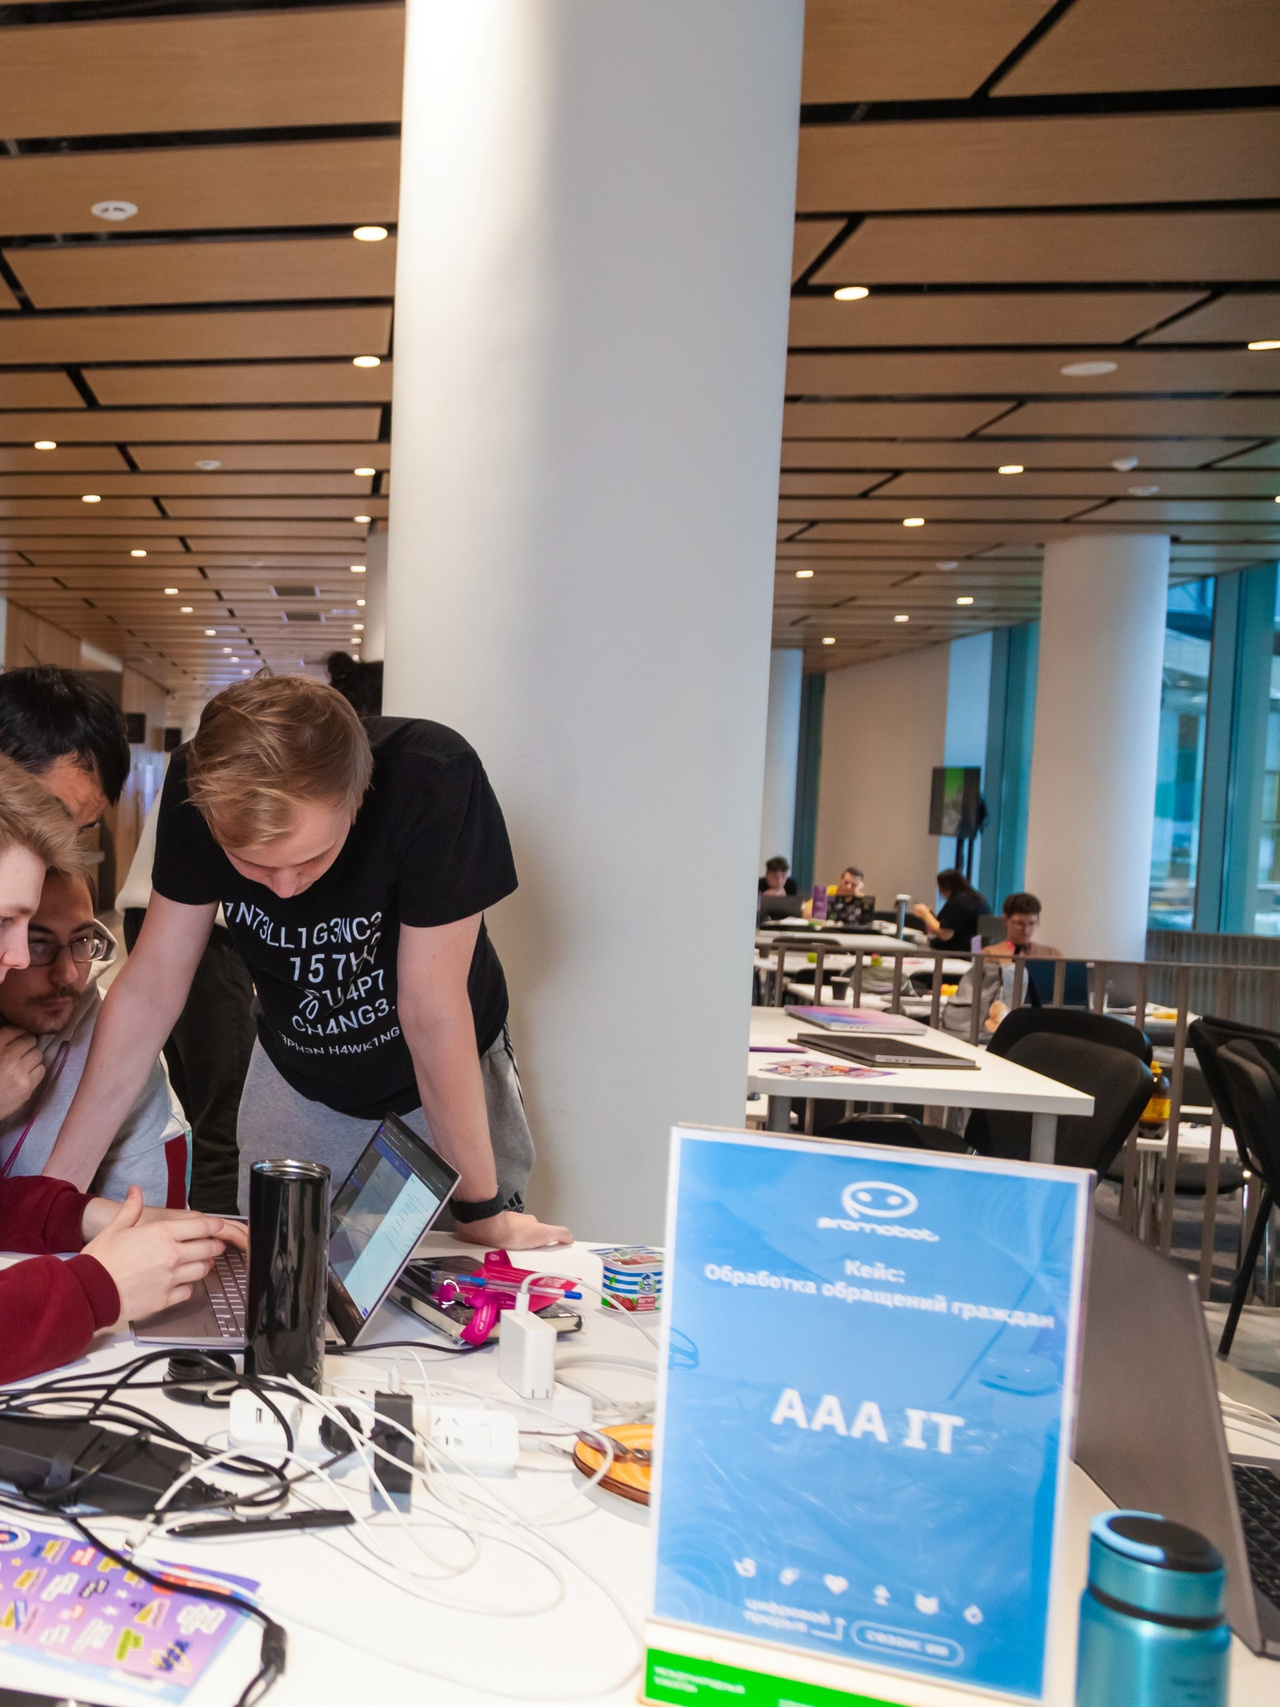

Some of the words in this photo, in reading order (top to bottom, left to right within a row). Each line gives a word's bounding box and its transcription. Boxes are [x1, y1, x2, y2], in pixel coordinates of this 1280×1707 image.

[329, 1026, 400, 1055] H4WK1NG
[844, 1259, 906, 1284] Кейс:
[704, 1263, 818, 1295] Обработка
[821, 1281, 948, 1314] обращений
[951, 1300, 1056, 1330] граждан
[902, 1407, 965, 1455] IT
